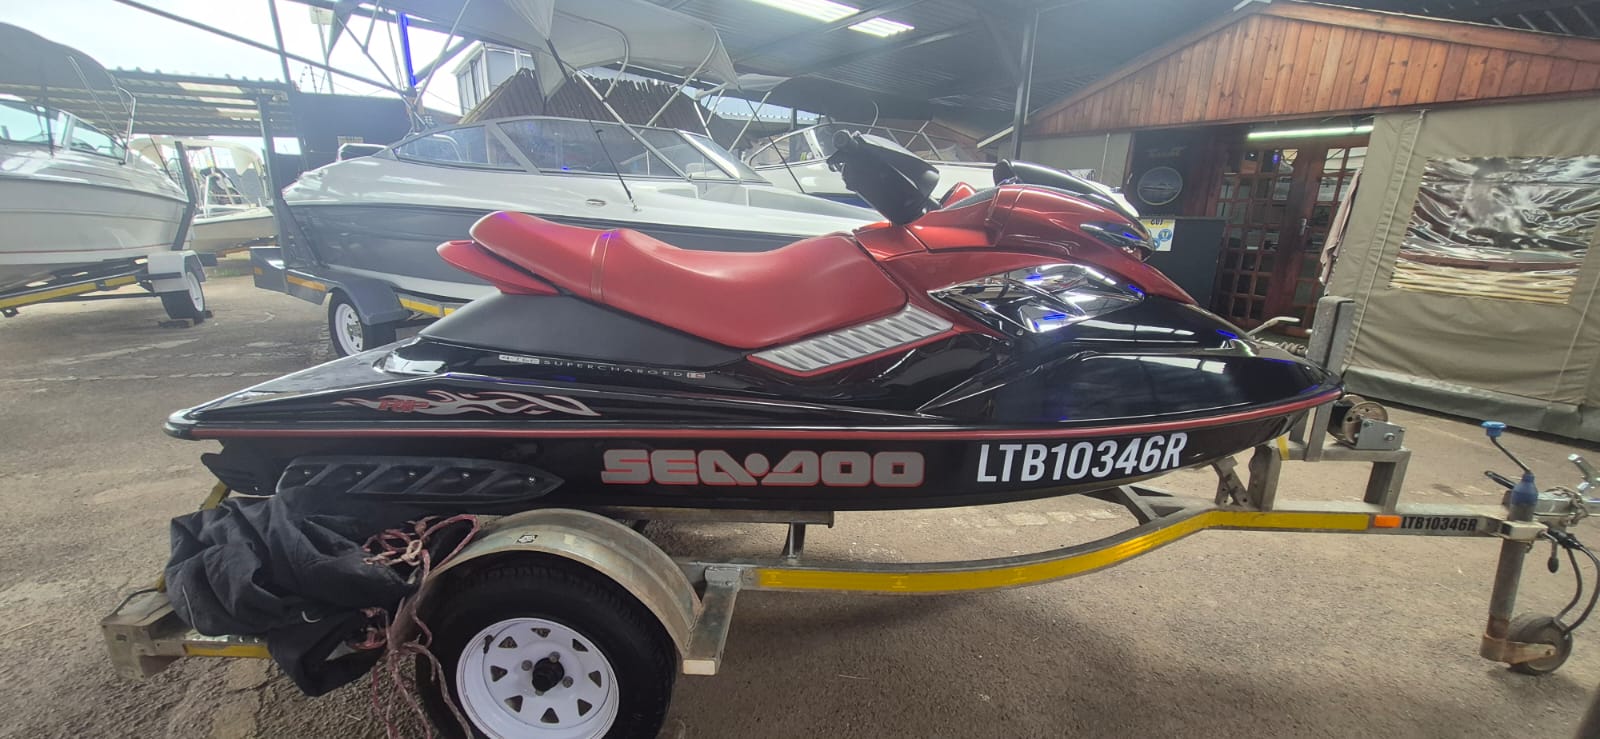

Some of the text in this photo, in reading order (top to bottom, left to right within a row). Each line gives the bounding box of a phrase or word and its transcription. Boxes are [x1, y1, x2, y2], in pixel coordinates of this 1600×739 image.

[543, 360, 682, 377] SUPERCHARGED
[977, 432, 1188, 483] LTB10346R
[1401, 516, 1478, 532] LTB10346R
